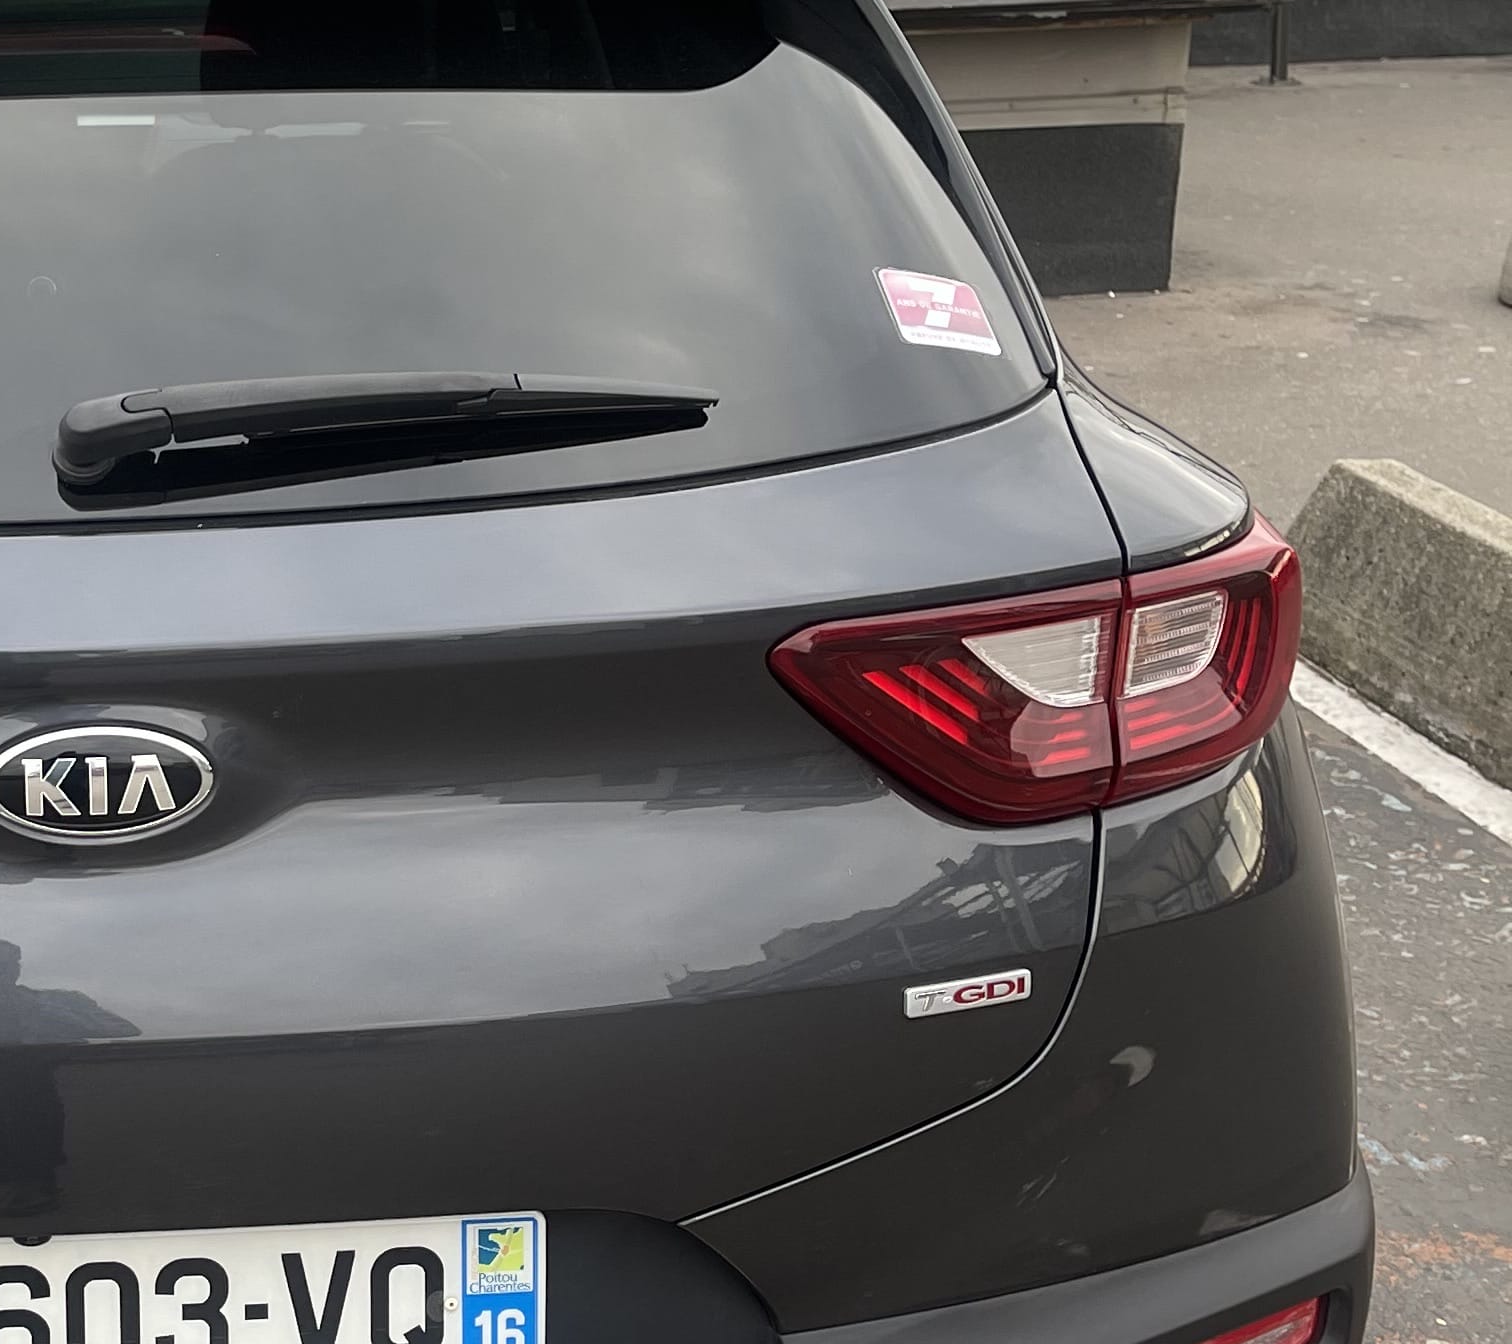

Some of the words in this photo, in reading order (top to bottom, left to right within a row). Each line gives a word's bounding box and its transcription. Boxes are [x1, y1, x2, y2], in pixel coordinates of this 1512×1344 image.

[21, 753, 176, 816] KIA
[479, 1272, 518, 1285] Poitou
[469, 1280, 531, 1294] Charentes
